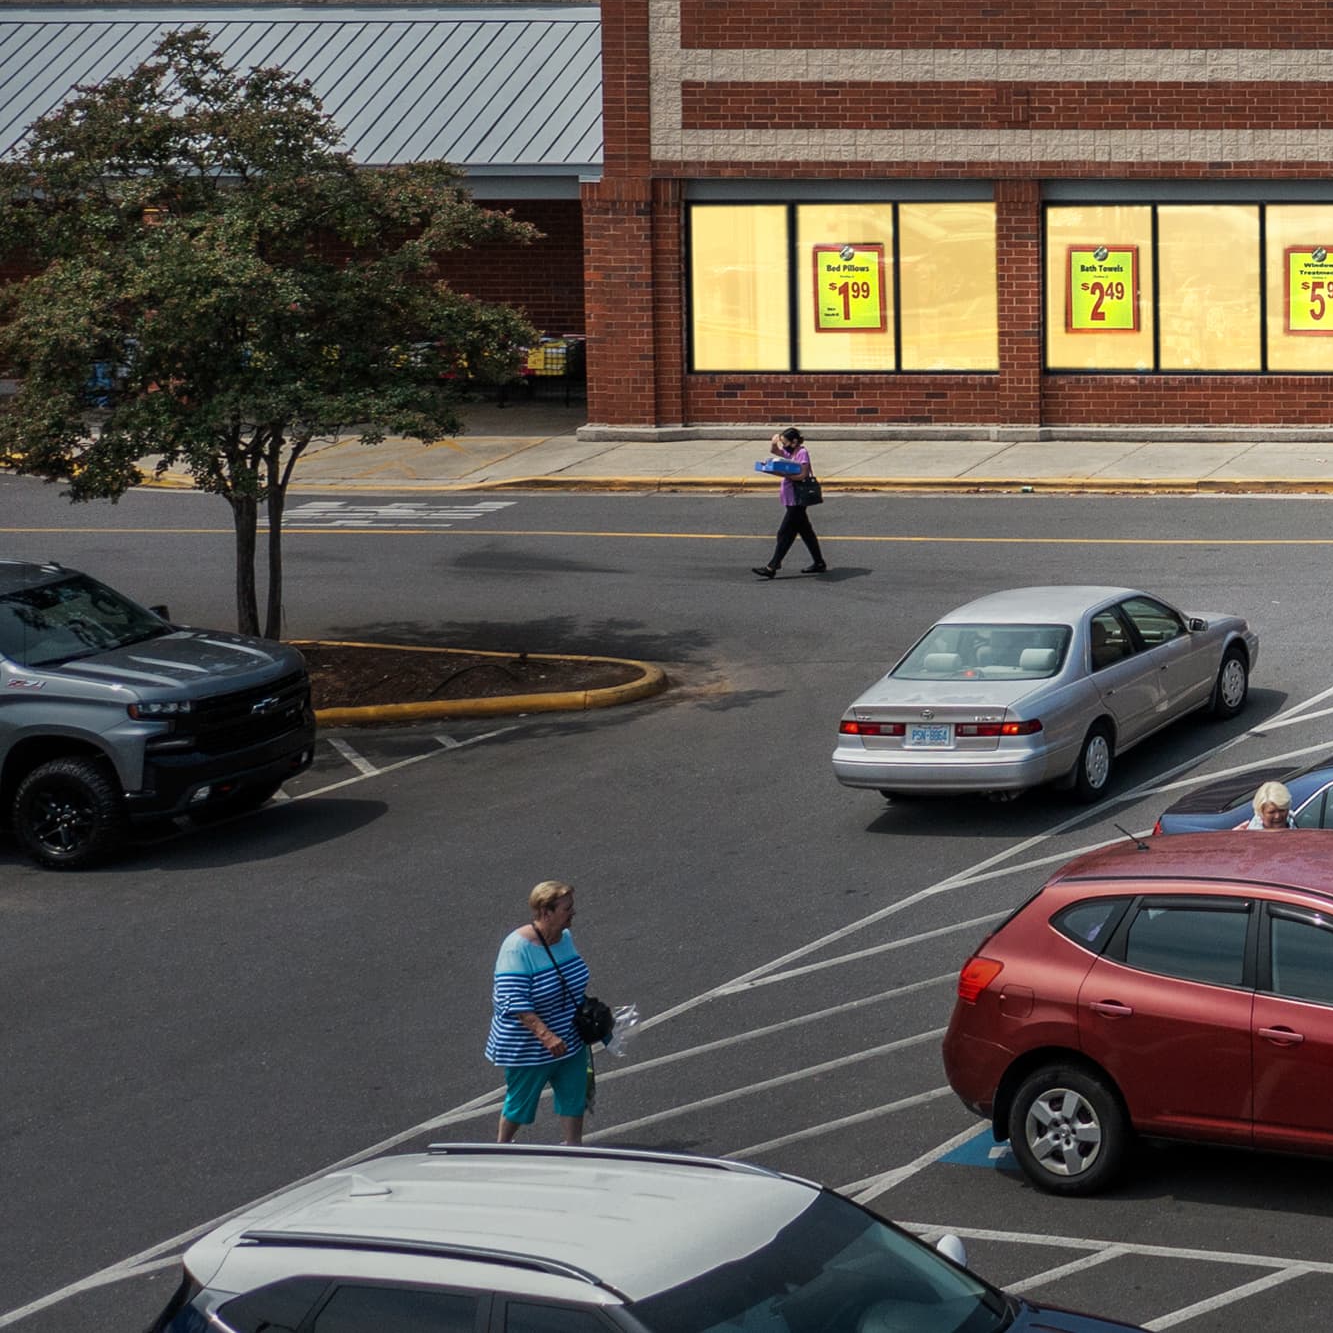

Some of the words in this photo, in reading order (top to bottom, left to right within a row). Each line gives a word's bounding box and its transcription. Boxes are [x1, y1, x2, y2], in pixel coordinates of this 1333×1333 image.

[826, 264, 841, 272] Bed
[842, 264, 870, 272] Pillows
[1080, 264, 1097, 272] Bath
[1098, 264, 1124, 272] Towels
